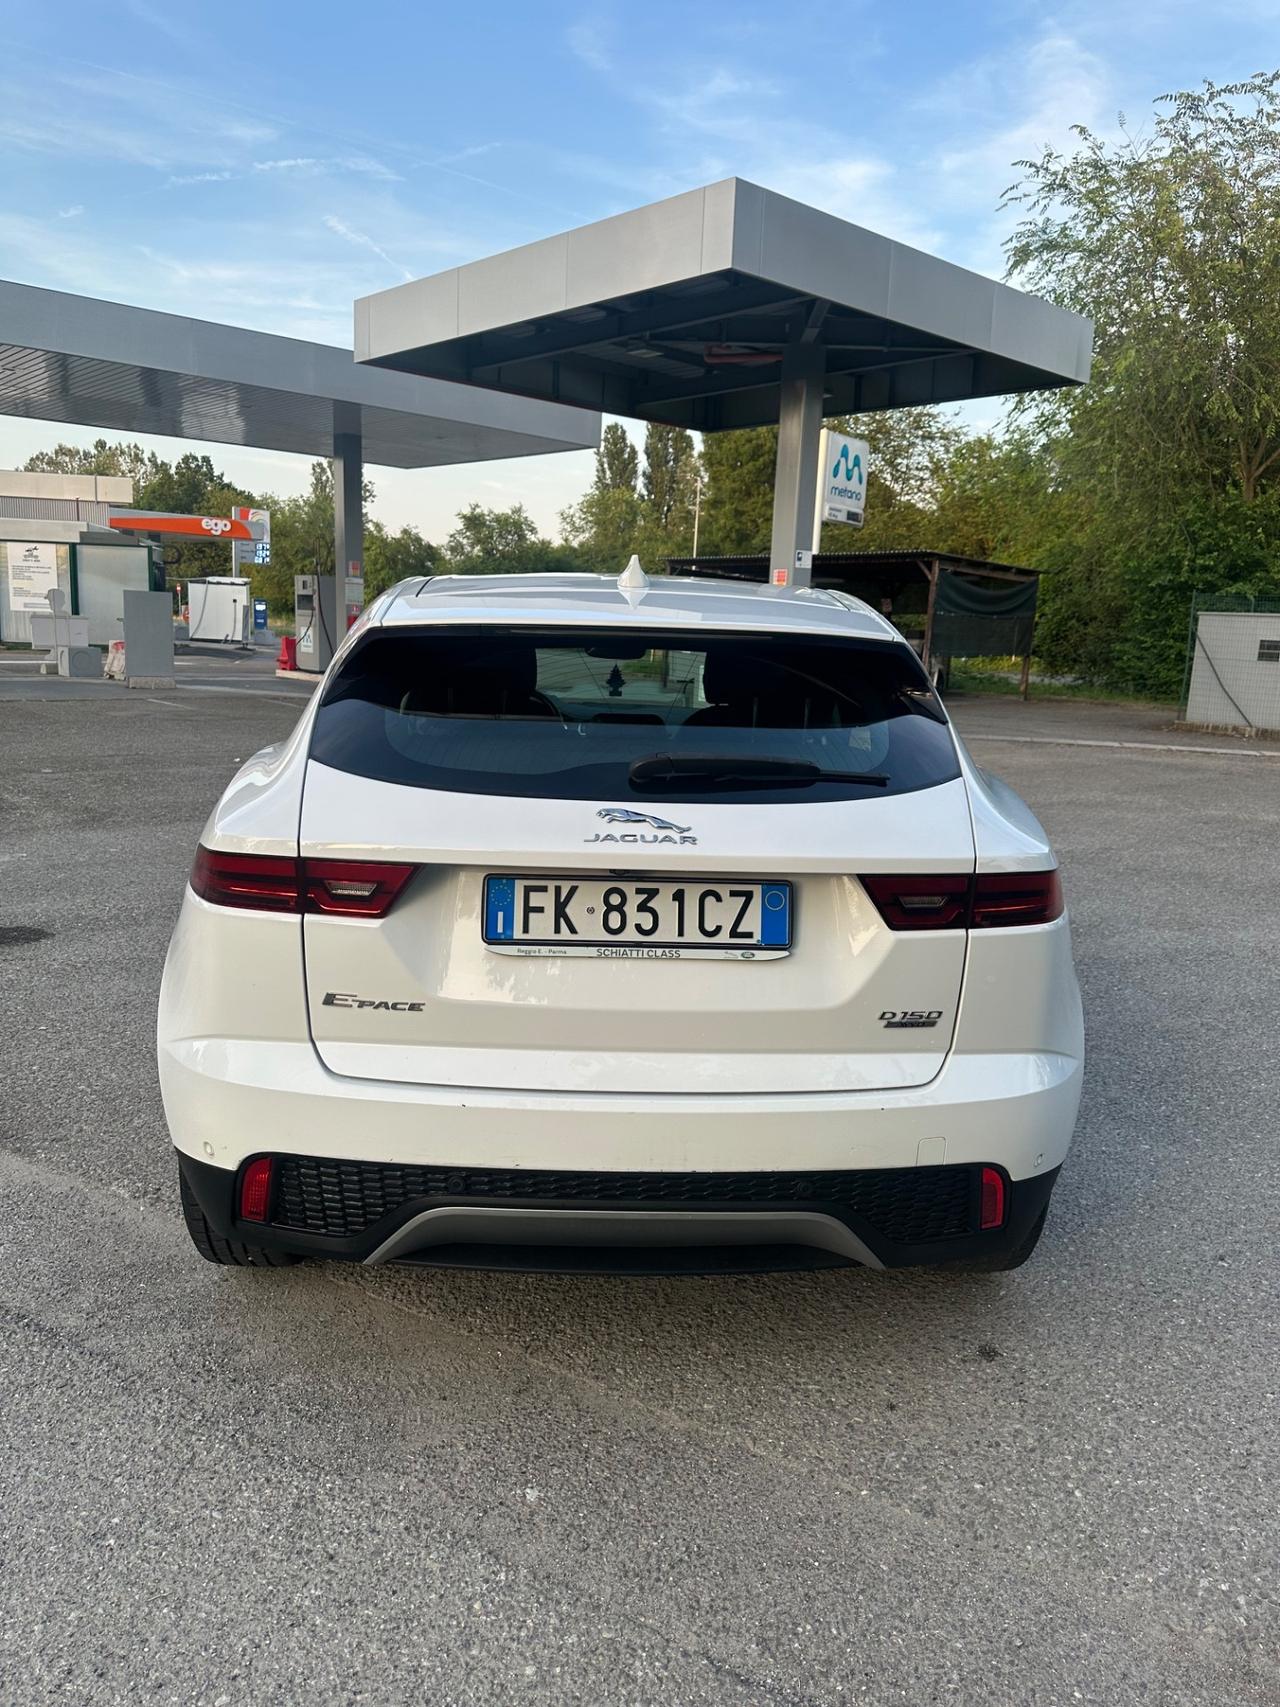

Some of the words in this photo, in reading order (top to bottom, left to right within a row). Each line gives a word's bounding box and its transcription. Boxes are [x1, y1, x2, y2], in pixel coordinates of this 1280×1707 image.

[830, 485, 862, 502] metano
[201, 518, 232, 536] ego
[583, 832, 698, 845] JAGUAR
[521, 884, 580, 935] FK
[601, 886, 755, 939] 831CZ
[596, 948, 644, 958] SCHIATTI
[647, 949, 681, 959] CLASS
